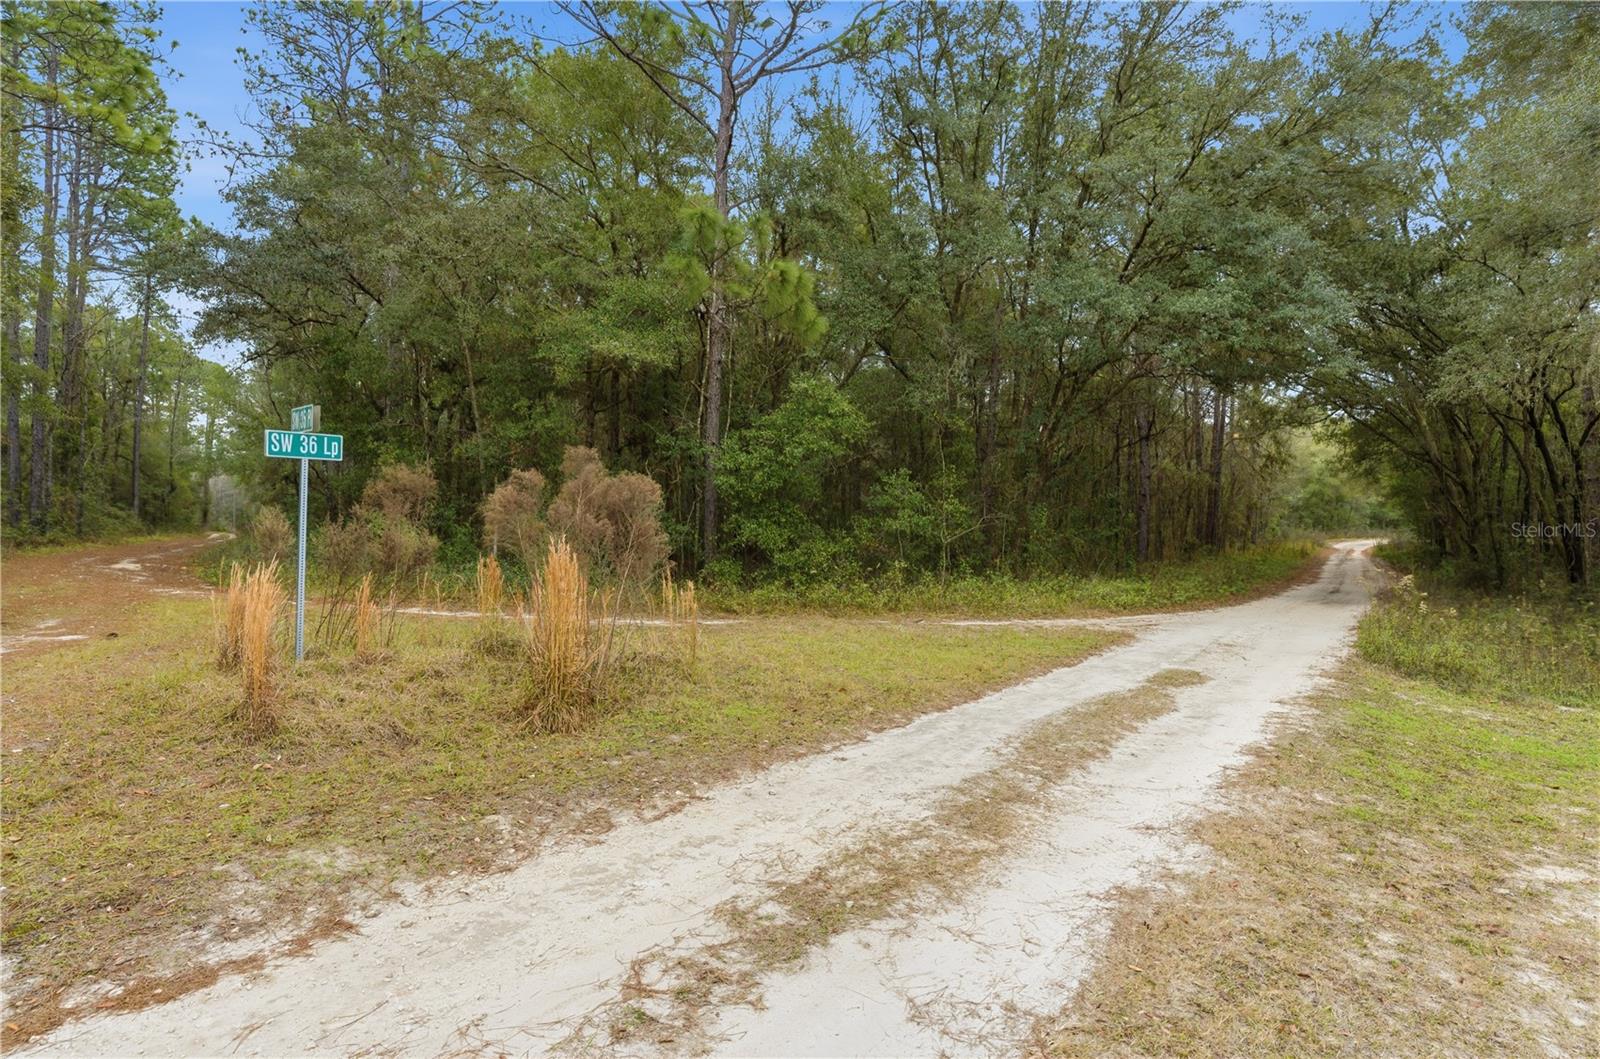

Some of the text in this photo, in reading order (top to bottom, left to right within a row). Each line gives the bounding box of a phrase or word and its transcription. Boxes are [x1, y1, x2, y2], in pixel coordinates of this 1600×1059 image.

[271, 433, 338, 458] SW 36 Lp
